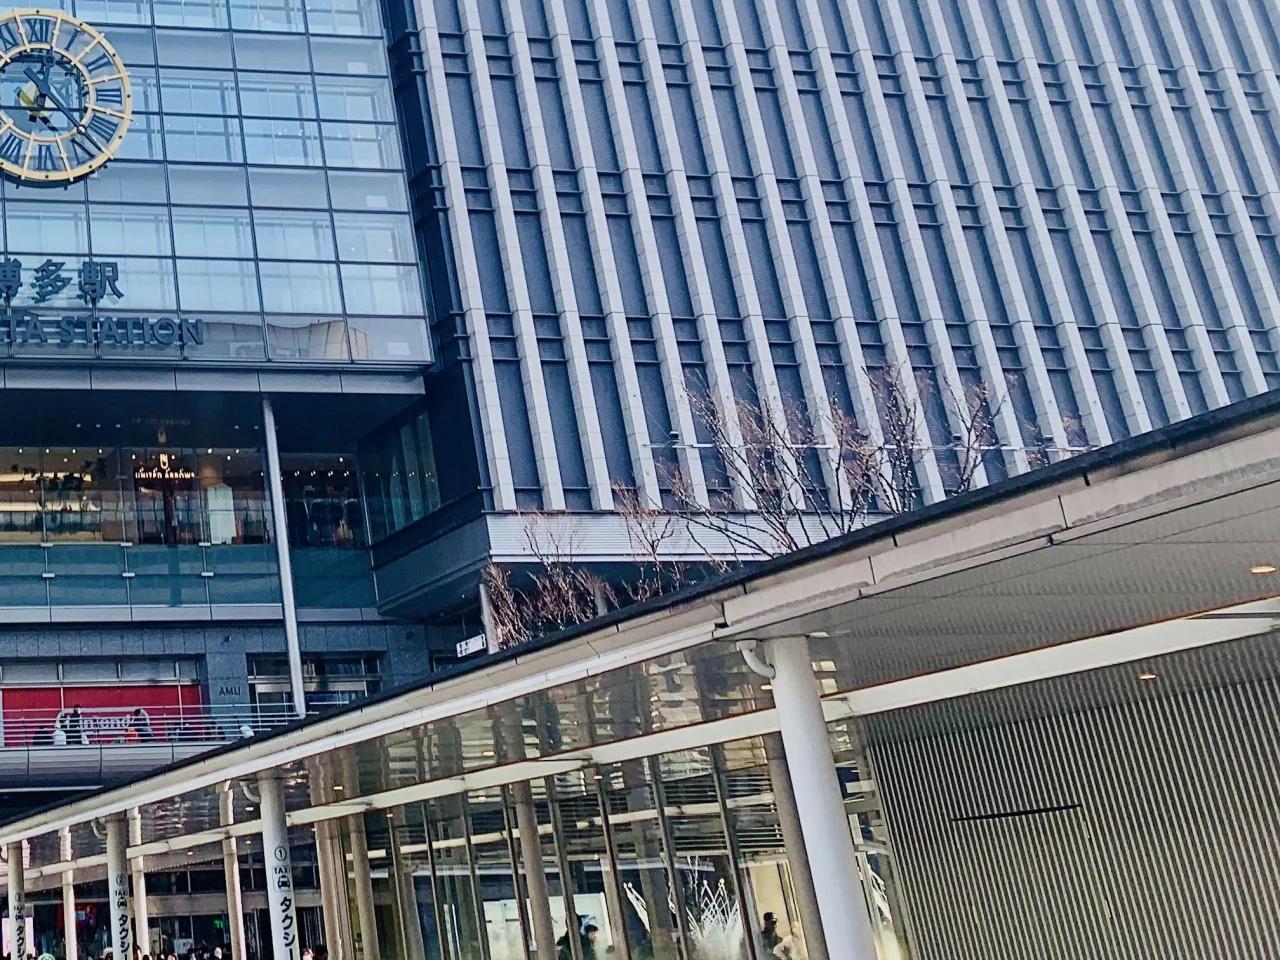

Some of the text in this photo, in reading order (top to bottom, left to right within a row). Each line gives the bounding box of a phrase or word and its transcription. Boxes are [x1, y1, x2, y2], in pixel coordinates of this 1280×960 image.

[25, 18, 51, 43] XII
[65, 28, 81, 51] I
[85, 52, 113, 74] II
[96, 86, 123, 106] III
[37, 144, 60, 170] VI
[72, 138, 95, 166] V
[60, 315, 205, 345] STATION
[219, 685, 241, 696] AMU
[66, 713, 140, 730] intend
[273, 867, 292, 875] TAXI
[280, 896, 296, 960] タクシー
